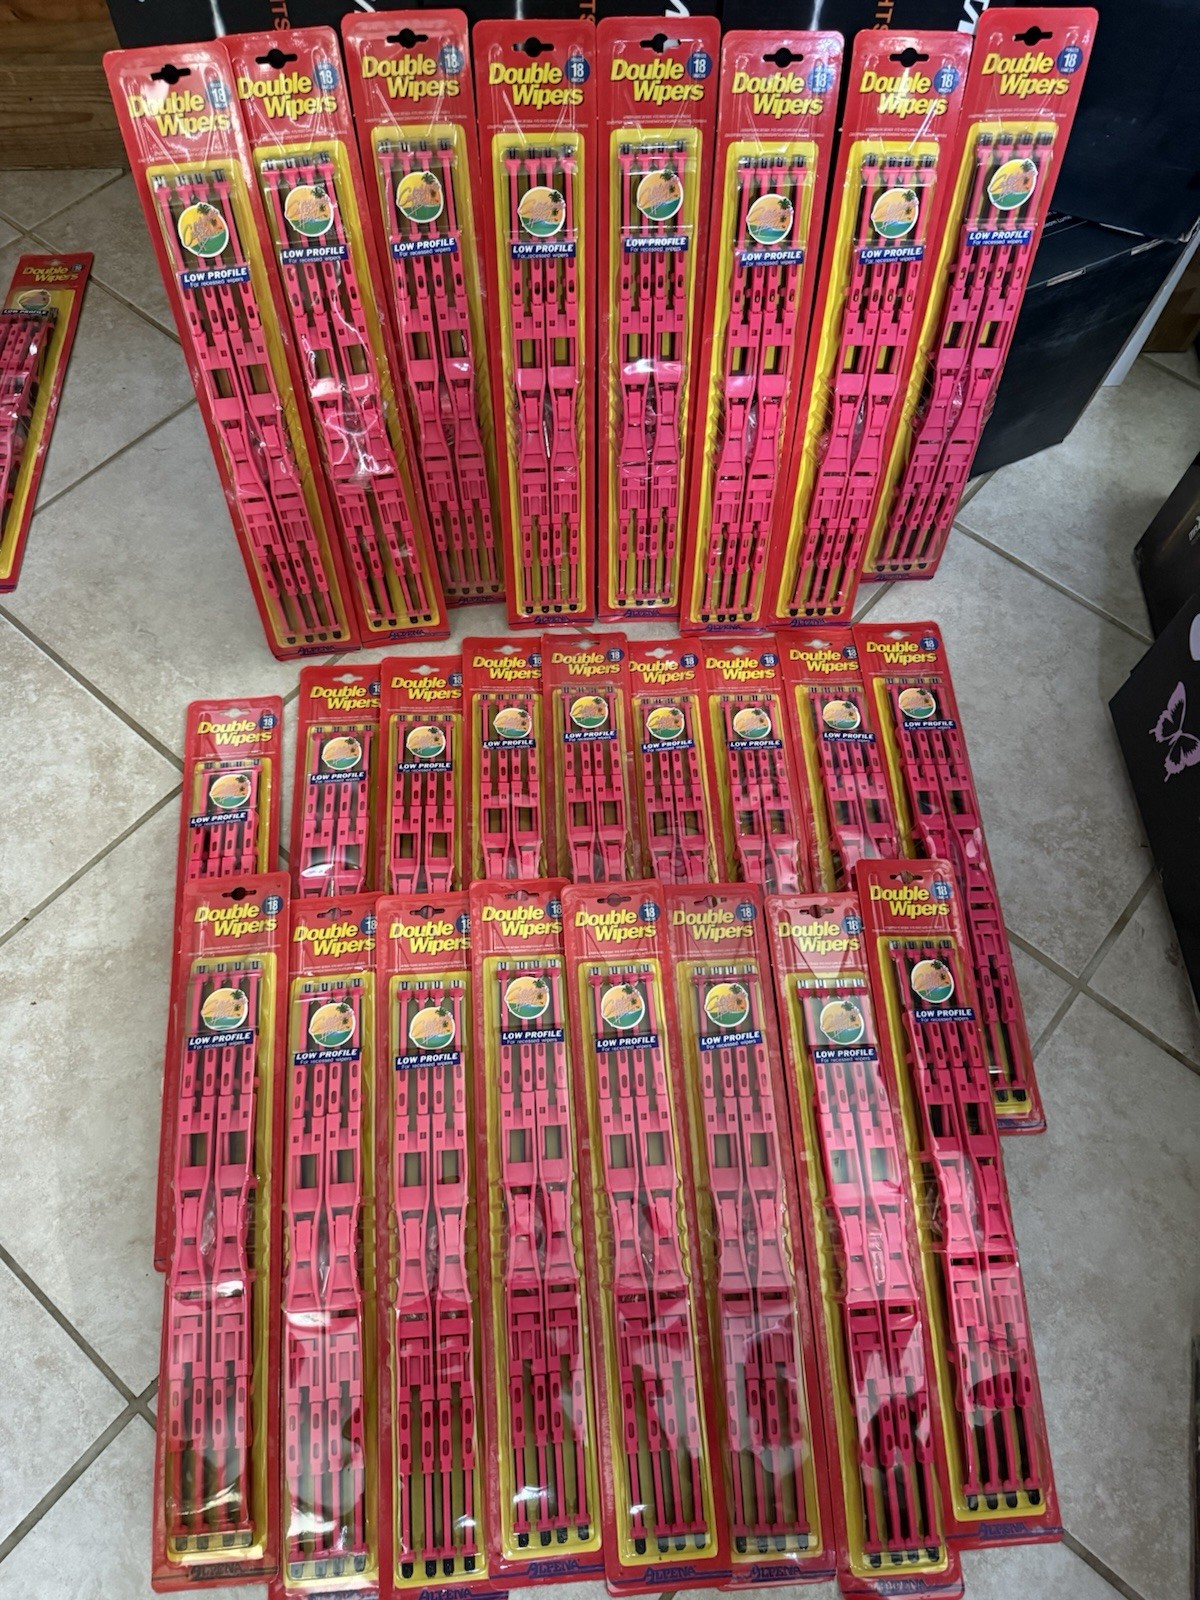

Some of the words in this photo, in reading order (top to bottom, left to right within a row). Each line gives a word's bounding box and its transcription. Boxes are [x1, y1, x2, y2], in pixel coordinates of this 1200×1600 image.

[362, 54, 436, 78] Double
[446, 53, 459, 68] 18
[694, 59, 706, 72] 18
[982, 52, 1054, 75] Double
[1063, 52, 1078, 67] 18
[320, 69, 332, 84] 18
[489, 62, 562, 85] Double
[571, 62, 584, 78] 18
[611, 59, 684, 81] Double
[238, 72, 311, 98] Double
[731, 72, 804, 94] Double
[813, 73, 826, 88] 18
[859, 72, 931, 94] Double
[940, 73, 953, 88] 18
[999, 74, 1069, 98] Wipers
[211, 87, 225, 102] 18
[386, 77, 459, 102] Wipers
[512, 85, 583, 109] Wipers
[633, 81, 704, 105] Wipers
[128, 91, 204, 117] Double
[264, 94, 336, 119] Wipers
[753, 94, 823, 119] Wipers
[878, 94, 948, 118] Wipers
[157, 112, 230, 138] Wipers
[626, 239, 648, 248] LOW
[650, 238, 686, 246] PROFILE
[969, 232, 993, 241] LOW
[993, 231, 1030, 239] PROFILE
[394, 242, 417, 252] LOW
[418, 238, 455, 249] PROFILE
[512, 245, 536, 253] LOW
[537, 244, 573, 253] PROFILE
[283, 250, 306, 262] LOW
[307, 246, 345, 259] PROFILE
[742, 252, 765, 261] LOW
[765, 251, 802, 260] PROFILE
[861, 249, 884, 259] LOW
[886, 248, 921, 257] PROFILE
[184, 272, 207, 283] LOW
[208, 268, 247, 281] PROFILE
[790, 650, 840, 660] Double
[866, 642, 918, 653] Double
[473, 656, 526, 669] Double
[552, 652, 604, 666] Double
[706, 658, 758, 670] Double
[884, 652, 936, 665] Wipers
[490, 668, 540, 681] Wipers
[568, 664, 620, 677] Wipers
[629, 661, 678, 673] Double
[723, 668, 775, 681] Wipers
[806, 660, 858, 674] Wipers
[391, 677, 446, 690] Double
[642, 670, 694, 684] Wipers
[310, 686, 366, 699] Double
[408, 688, 461, 702] Wipers
[327, 697, 380, 712] Wipers
[198, 720, 256, 735] Double
[585, 730, 615, 738] PROFILE
[216, 730, 272, 748] Wipers
[643, 742, 661, 750] LOW
[662, 740, 692, 748] PROFILE
[730, 740, 748, 748] LOW
[191, 816, 210, 824] LOW
[212, 812, 246, 821] PROFILE
[870, 886, 929, 900] Double
[936, 885, 947, 896] 18
[194, 903, 260, 923] Double
[267, 900, 278, 912] 18
[482, 906, 544, 921] Double
[551, 904, 562, 914] 18
[644, 907, 656, 918] 18
[741, 908, 752, 918] 18
[890, 901, 950, 917] Wipers
[574, 908, 637, 927] Double
[672, 908, 734, 926] Double
[214, 917, 277, 938] Wipers
[293, 923, 358, 942] Double
[366, 920, 376, 931] 18
[390, 922, 454, 939] Double
[502, 921, 562, 937] Wipers
[692, 923, 753, 942] Wipers
[779, 922, 840, 938] Double
[847, 920, 858, 930] 18
[594, 924, 656, 943] Wipers
[313, 937, 375, 957] Wipers
[410, 936, 470, 954] Wipers
[798, 936, 860, 955] Wipers
[190, 1036, 210, 1046] LOW
[212, 1032, 250, 1042] PROFILE
[503, 1032, 522, 1040] LOW
[525, 1030, 562, 1038] PROFILE
[598, 1039, 618, 1047] LOW
[620, 1036, 656, 1044] PROFILE
[702, 1036, 720, 1044] LOW
[722, 1032, 760, 1042] PROFILE
[295, 1052, 316, 1060] LOW
[318, 1050, 358, 1058] PROFILE
[397, 1056, 417, 1065] LOW
[419, 1053, 458, 1062] PROFILE
[528, 1560, 579, 1579] ALPENA
